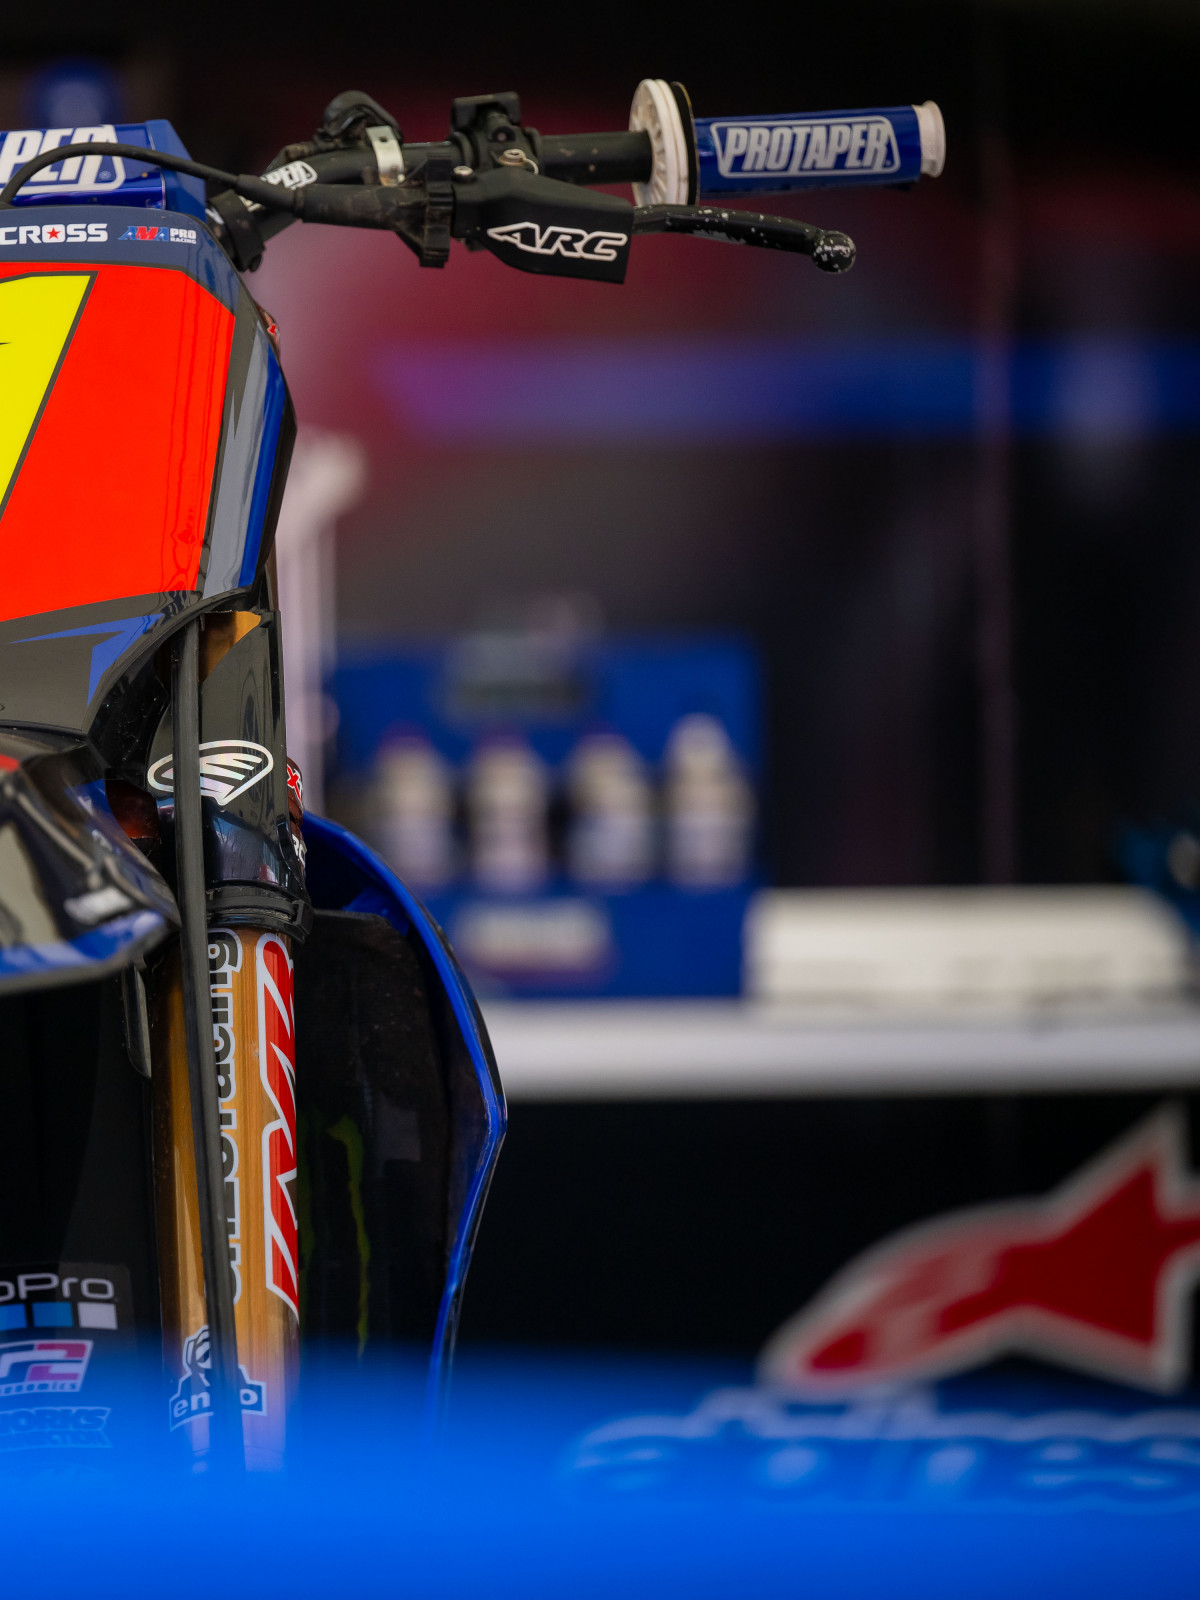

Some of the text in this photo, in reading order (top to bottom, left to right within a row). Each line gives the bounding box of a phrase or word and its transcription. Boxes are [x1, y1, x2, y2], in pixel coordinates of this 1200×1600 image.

[720, 122, 892, 174] PROTAPER
[118, 225, 197, 242] AMA PRO
[169, 236, 197, 245] RACING
[487, 222, 628, 262] ARC
[173, 1388, 259, 1418] eno
